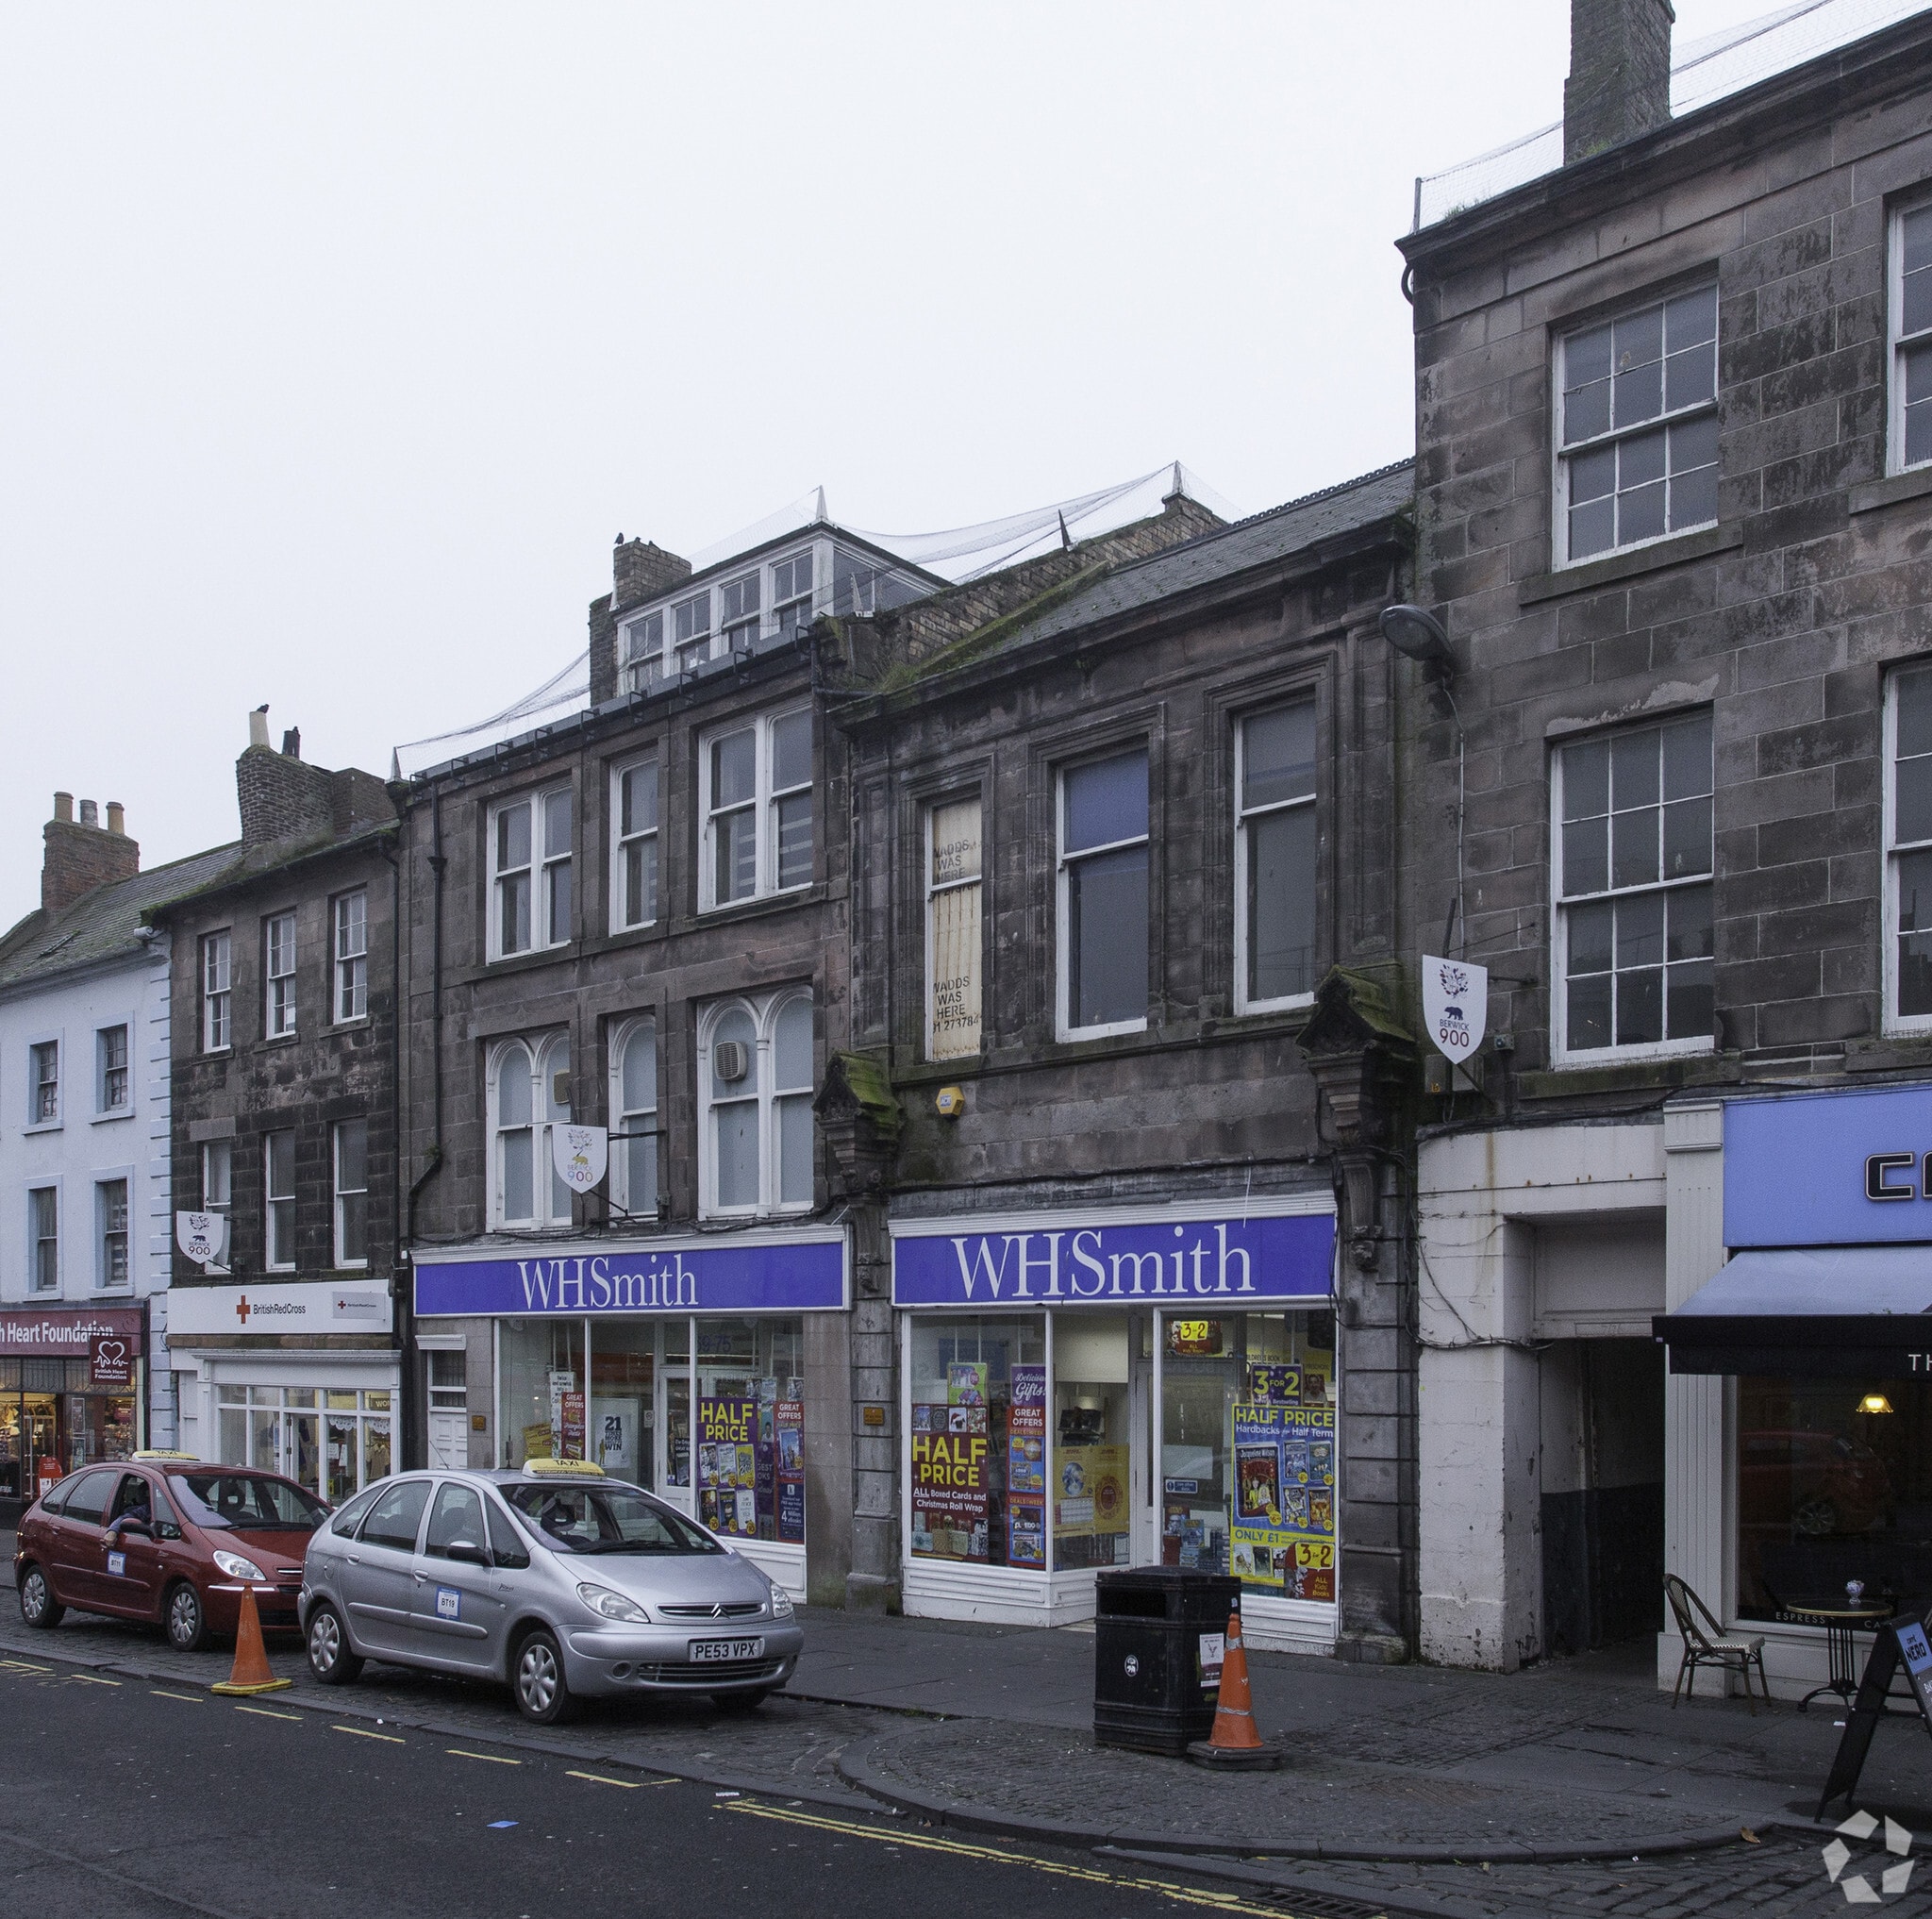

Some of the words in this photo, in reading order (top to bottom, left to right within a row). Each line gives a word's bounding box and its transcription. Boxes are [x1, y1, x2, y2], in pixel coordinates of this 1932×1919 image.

[938, 991, 961, 1006] WAS
[937, 1004, 965, 1019] HERE
[1440, 1019, 1469, 1030] BERWICK
[1440, 1027, 1470, 1047] 900
[568, 1171, 593, 1182] 900
[189, 1246, 210, 1256] 900
[951, 1224, 1256, 1299] WHSmith
[518, 1254, 698, 1310] WHSmith
[253, 1304, 306, 1315] BritishRedCross
[8, 1322, 40, 1343] Heart
[1183, 1323, 1191, 1339] 3
[1197, 1323, 1206, 1339] 2
[1254, 1371, 1269, 1395] 3
[1284, 1372, 1299, 1395] 2
[701, 1402, 753, 1425] HALF
[1014, 1409, 1041, 1417] GREAT
[1236, 1408, 1278, 1424] HALF
[1285, 1410, 1333, 1427] PRICE
[605, 1416, 622, 1431] 21
[1012, 1418, 1043, 1427] OFFERS
[706, 1425, 749, 1442] PRICE
[1236, 1425, 1280, 1434] Hardbacks
[1291, 1427, 1309, 1436] Half
[1311, 1428, 1333, 1438] Term
[912, 1435, 987, 1465] HALF
[920, 1463, 979, 1487] PRICE
[913, 1487, 930, 1497] ALL
[931, 1490, 950, 1498] Boxed
[952, 1492, 972, 1500] Cards
[917, 1499, 948, 1510] Christmas
[949, 1502, 962, 1510] Roll
[963, 1503, 984, 1513] Wrap
[781, 1510, 788, 1522] 4
[1235, 1529, 1264, 1541] ONLY
[1268, 1533, 1279, 1543] £1
[1299, 1544, 1311, 1565] 3
[1321, 1545, 1331, 1567] 2
[695, 1644, 729, 1659] PE53
[733, 1643, 755, 1657] VPX
